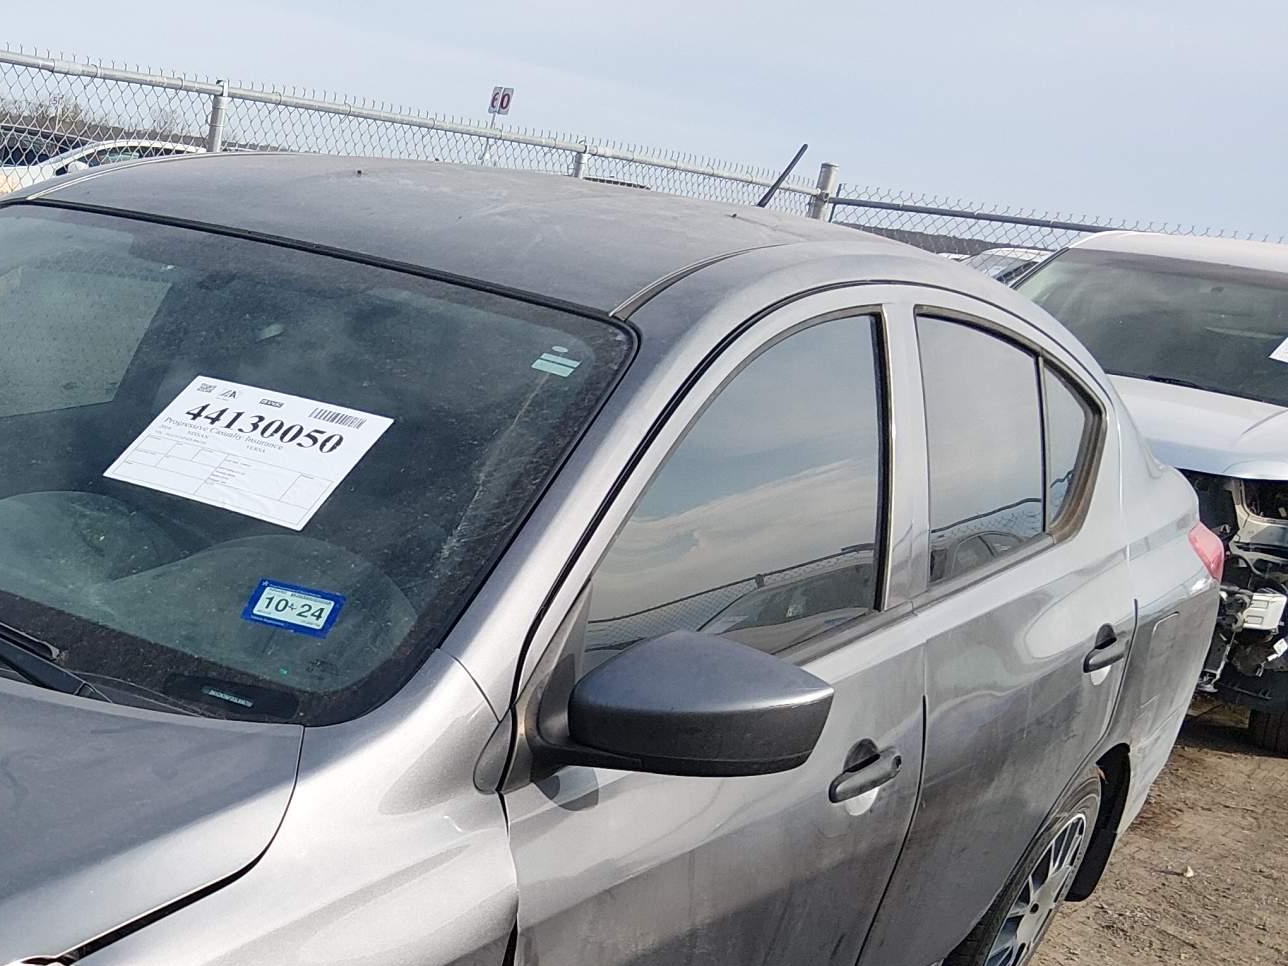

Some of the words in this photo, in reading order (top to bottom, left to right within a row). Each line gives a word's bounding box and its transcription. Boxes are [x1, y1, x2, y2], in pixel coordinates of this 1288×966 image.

[185, 403, 344, 453] 44130050
[265, 596, 289, 612] 10
[296, 603, 325, 620] 24
